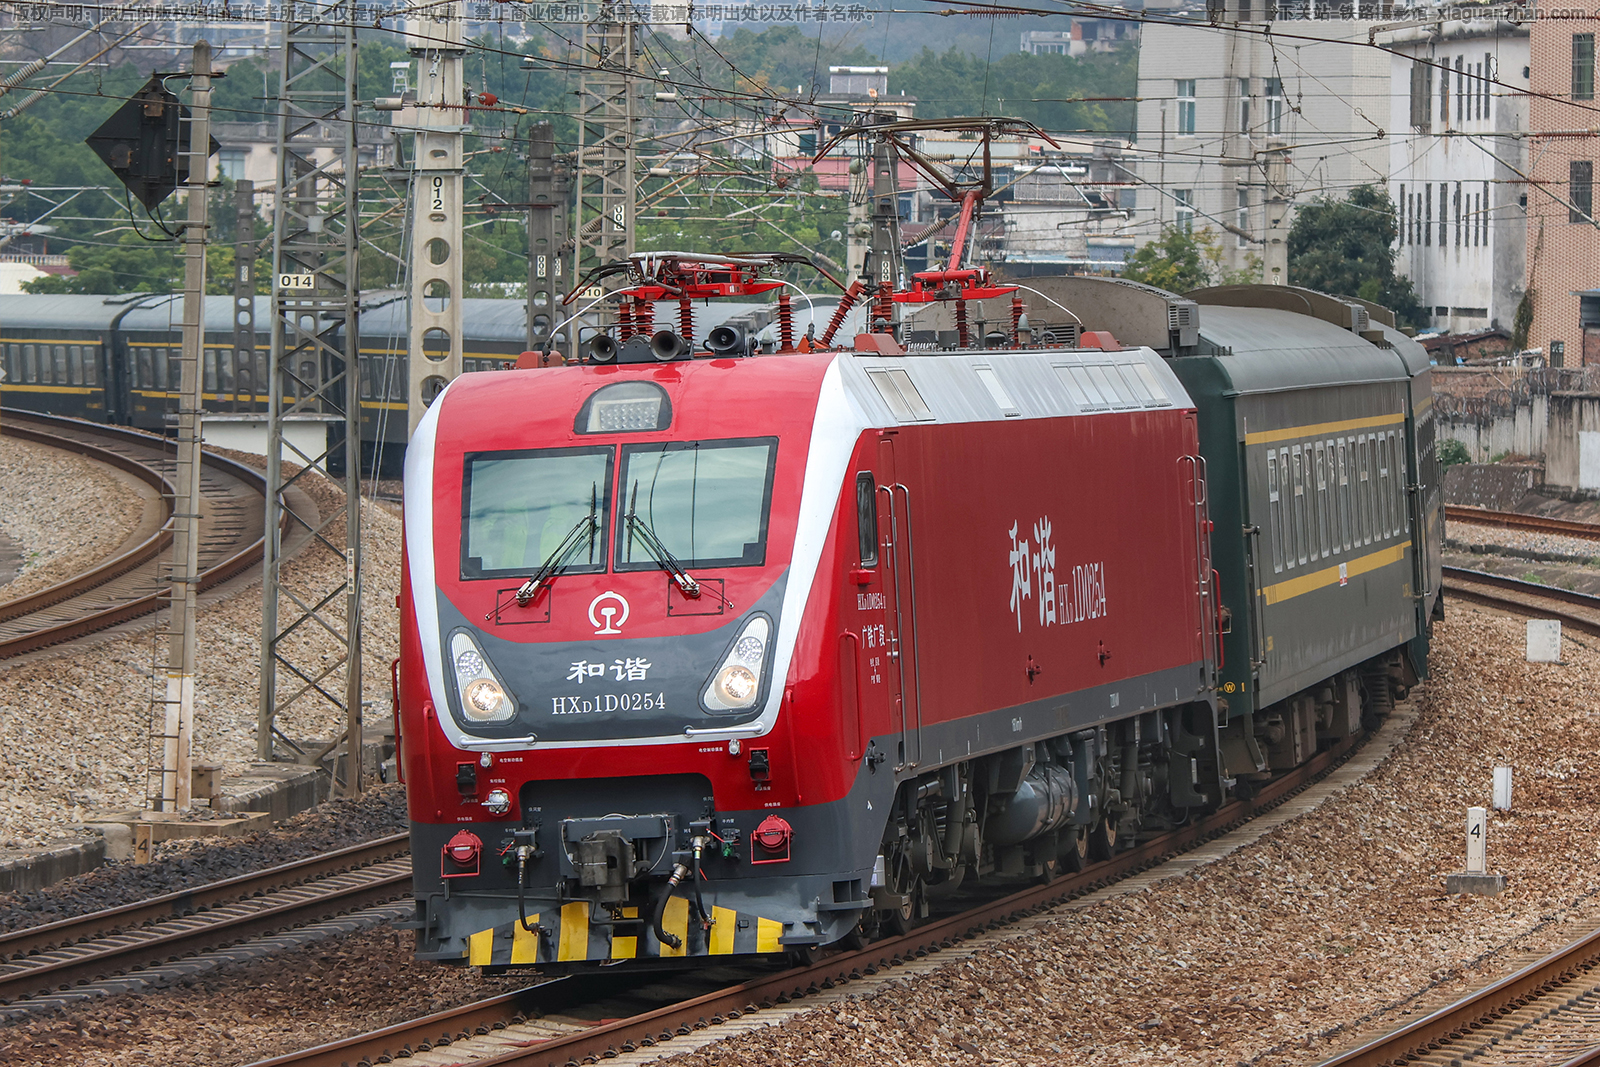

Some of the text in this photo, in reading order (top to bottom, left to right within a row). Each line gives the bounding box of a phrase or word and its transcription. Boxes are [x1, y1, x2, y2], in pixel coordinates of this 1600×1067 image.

[433, 176, 443, 210] 012
[281, 275, 312, 287] 014
[1008, 515, 1057, 633] 和谐
[566, 657, 652, 684] 和谐
[551, 691, 666, 715] HXD1D0254
[1470, 823, 1481, 839] 4
[138, 838, 148, 854] 4
